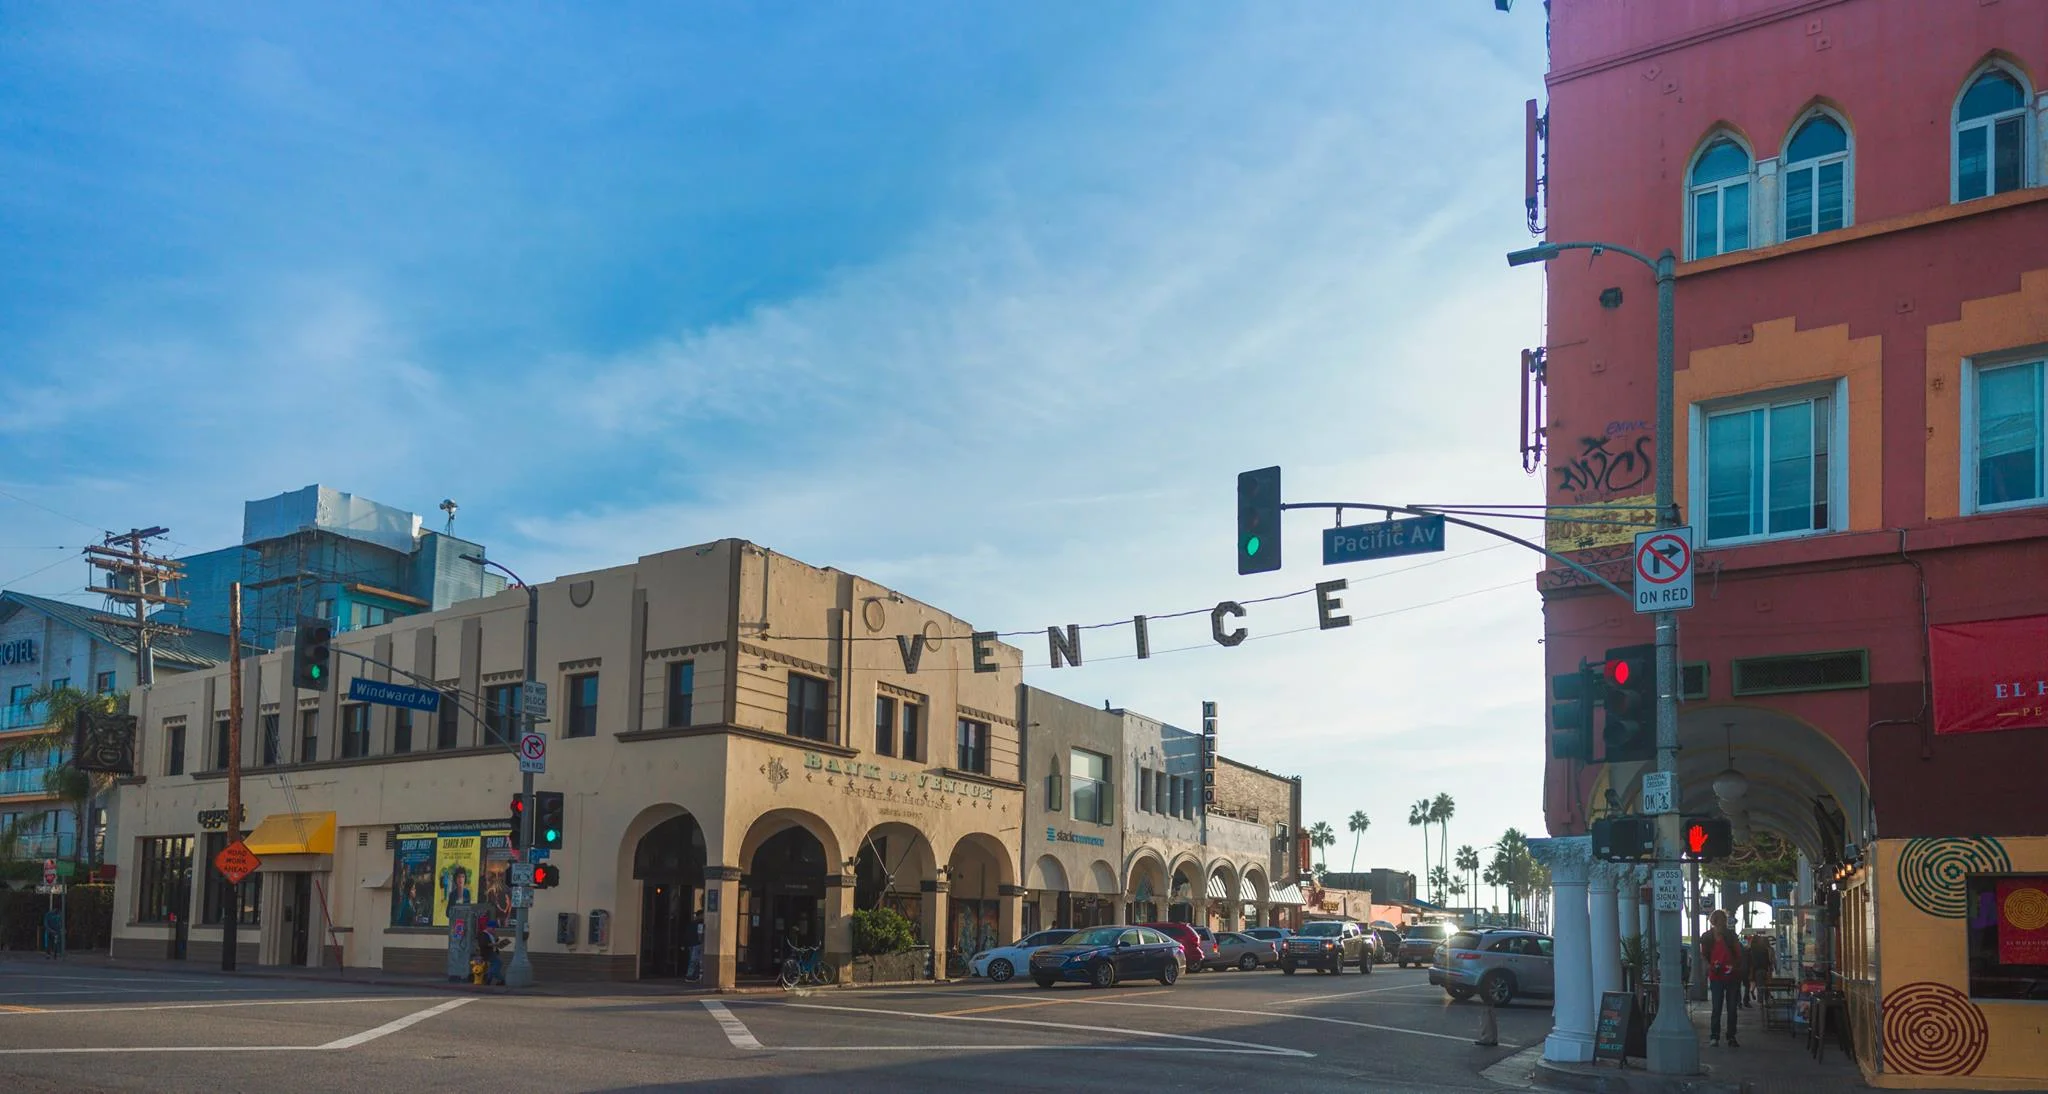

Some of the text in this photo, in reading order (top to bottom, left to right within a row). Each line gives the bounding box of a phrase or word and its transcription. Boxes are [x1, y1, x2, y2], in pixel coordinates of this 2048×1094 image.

[1334, 525, 1437, 553] Pacific Av
[1640, 587, 1688, 604] ON RED
[896, 578, 1352, 674] VENICE
[356, 683, 434, 706] Windward Av
[1995, 683, 2026, 699] EL
[526, 695, 545, 704] BLOCK
[1205, 703, 1214, 800] TATTOO
[532, 762, 544, 770] RED
[804, 752, 881, 780] BANK
[916, 773, 994, 801] VENICE
[1645, 794, 1656, 810] OK
[402, 839, 432, 850] SEARCH PARTY
[443, 838, 474, 849] SEARCH PARTY
[487, 837, 504, 848] SEARCH
[1657, 871, 1679, 879] CROSS
[1656, 893, 1679, 901] SIGNAL
